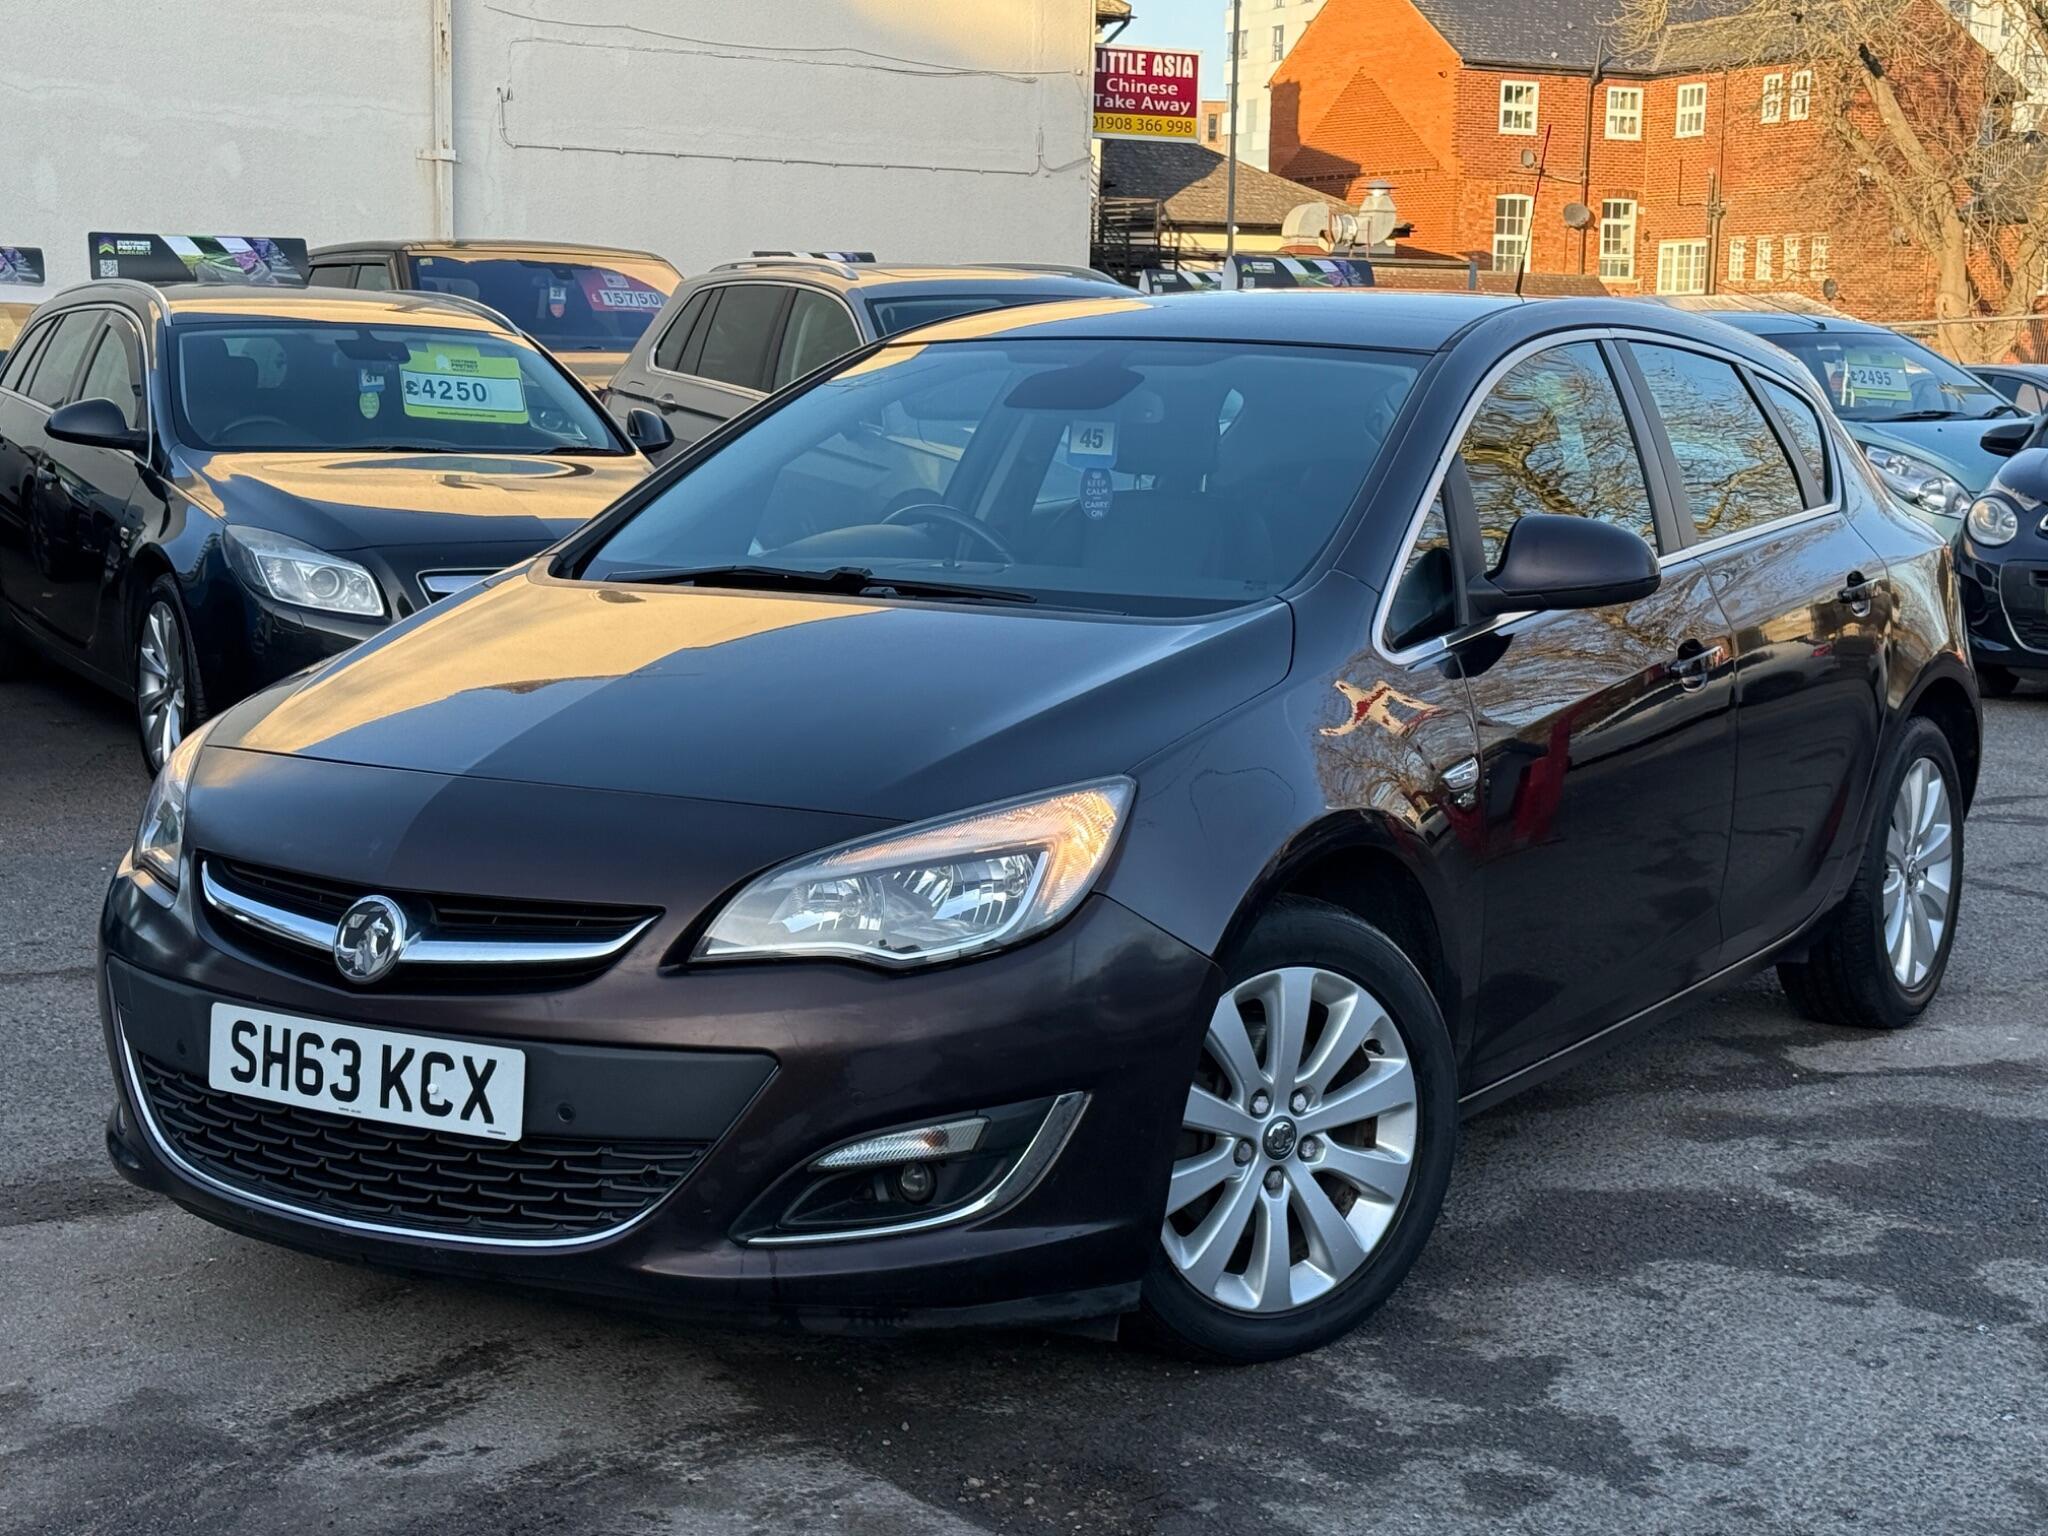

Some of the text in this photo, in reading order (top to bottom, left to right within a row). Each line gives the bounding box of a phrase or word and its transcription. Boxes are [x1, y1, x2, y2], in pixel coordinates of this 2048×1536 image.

[1152, 55, 1193, 78] ASIA
[1107, 78, 1178, 95] Chinese
[1095, 94, 1190, 115] Take Away
[1137, 119, 1162, 132] 366
[1167, 121, 1192, 133] 998
[406, 379, 487, 402] £4250
[1080, 428, 1104, 448] 45
[1085, 500, 1108, 508] CARRY
[1091, 509, 1102, 517] ON
[230, 1019, 497, 1124] SH63 KCX
